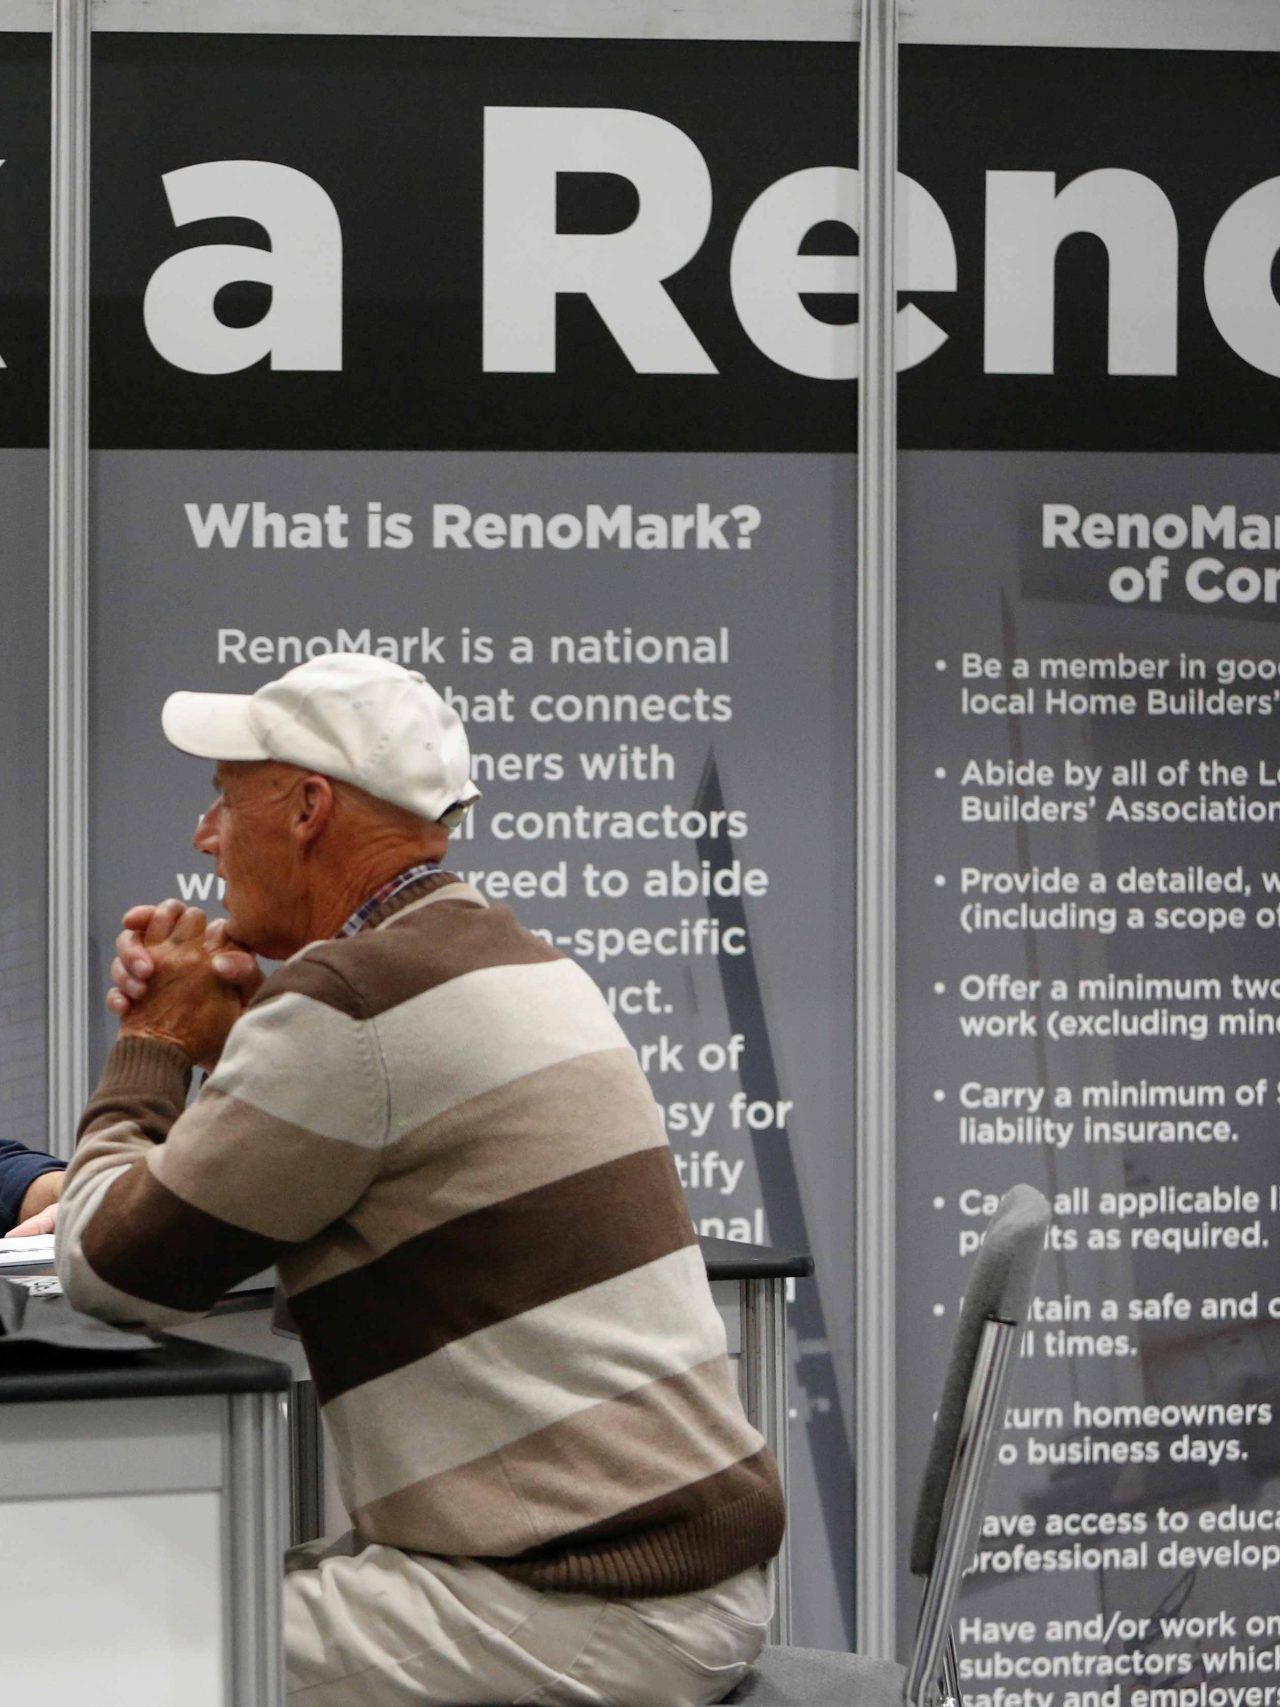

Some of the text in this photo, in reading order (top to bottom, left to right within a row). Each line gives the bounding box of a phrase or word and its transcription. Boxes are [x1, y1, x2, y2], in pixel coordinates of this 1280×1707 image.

[142, 160, 343, 375] a
[185, 502, 761, 549] What is RenoMark?
[1043, 504, 1280, 549] RenoMa
[1109, 556, 1169, 602] of
[462, 628, 494, 663] is
[510, 637, 533, 663] a
[551, 627, 728, 663] national
[963, 653, 1280, 684] Be a member in goo
[444, 686, 732, 722] hat connects
[962, 688, 1034, 714] local
[1046, 689, 1136, 715] Home
[580, 744, 674, 780] with
[961, 760, 1054, 786] Abide
[1065, 760, 1101, 791] by
[1112, 760, 1146, 786] all
[1158, 760, 1189, 786] of
[1199, 760, 1248, 786] the
[491, 805, 748, 840] contractors
[583, 864, 628, 897] to
[643, 860, 769, 898] abide
[961, 867, 1079, 893] Provide
[1089, 873, 1106, 893] a
[1117, 866, 1251, 896] detailed,
[960, 903, 1116, 933] (including
[1127, 908, 1144, 928] a
[1155, 908, 1246, 933] scope
[960, 974, 1041, 1001] Offer
[1051, 980, 1067, 1000] a
[1079, 974, 1221, 1000] minimum
[960, 1008, 1280, 1040] work (excluding min
[697, 1034, 744, 1073] of
[727, 1091, 794, 1131] for
[960, 1082, 1044, 1113] Carry
[1054, 1087, 1071, 1107] a
[1083, 1080, 1225, 1107] minimum
[1236, 1079, 1267, 1106] of
[960, 1116, 1238, 1148] liability insurance.
[1054, 1187, 1089, 1214] all
[1099, 1186, 1259, 1219] applicable
[1087, 1229, 1121, 1249] as
[1131, 1221, 1268, 1253] required.
[1101, 1300, 1118, 1320] a
[1129, 1293, 1191, 1320] safe
[1201, 1292, 1257, 1319] and
[1044, 1330, 1137, 1357] times.
[1073, 1400, 1272, 1428] homeowners
[1027, 1436, 1160, 1465] business
[1170, 1435, 1248, 1466] days.
[980, 1514, 1036, 1537] ave
[1045, 1513, 1147, 1535] access
[1157, 1508, 1189, 1533] to
[1158, 1540, 1280, 1570] develop
[959, 1617, 1036, 1643] Have
[1045, 1611, 1150, 1644] and/or
[1160, 1611, 1236, 1639] work
[959, 1645, 1280, 1680] subcontractors whic
[1063, 1684, 1120, 1707] and
[1131, 1682, 1280, 1707] employer
